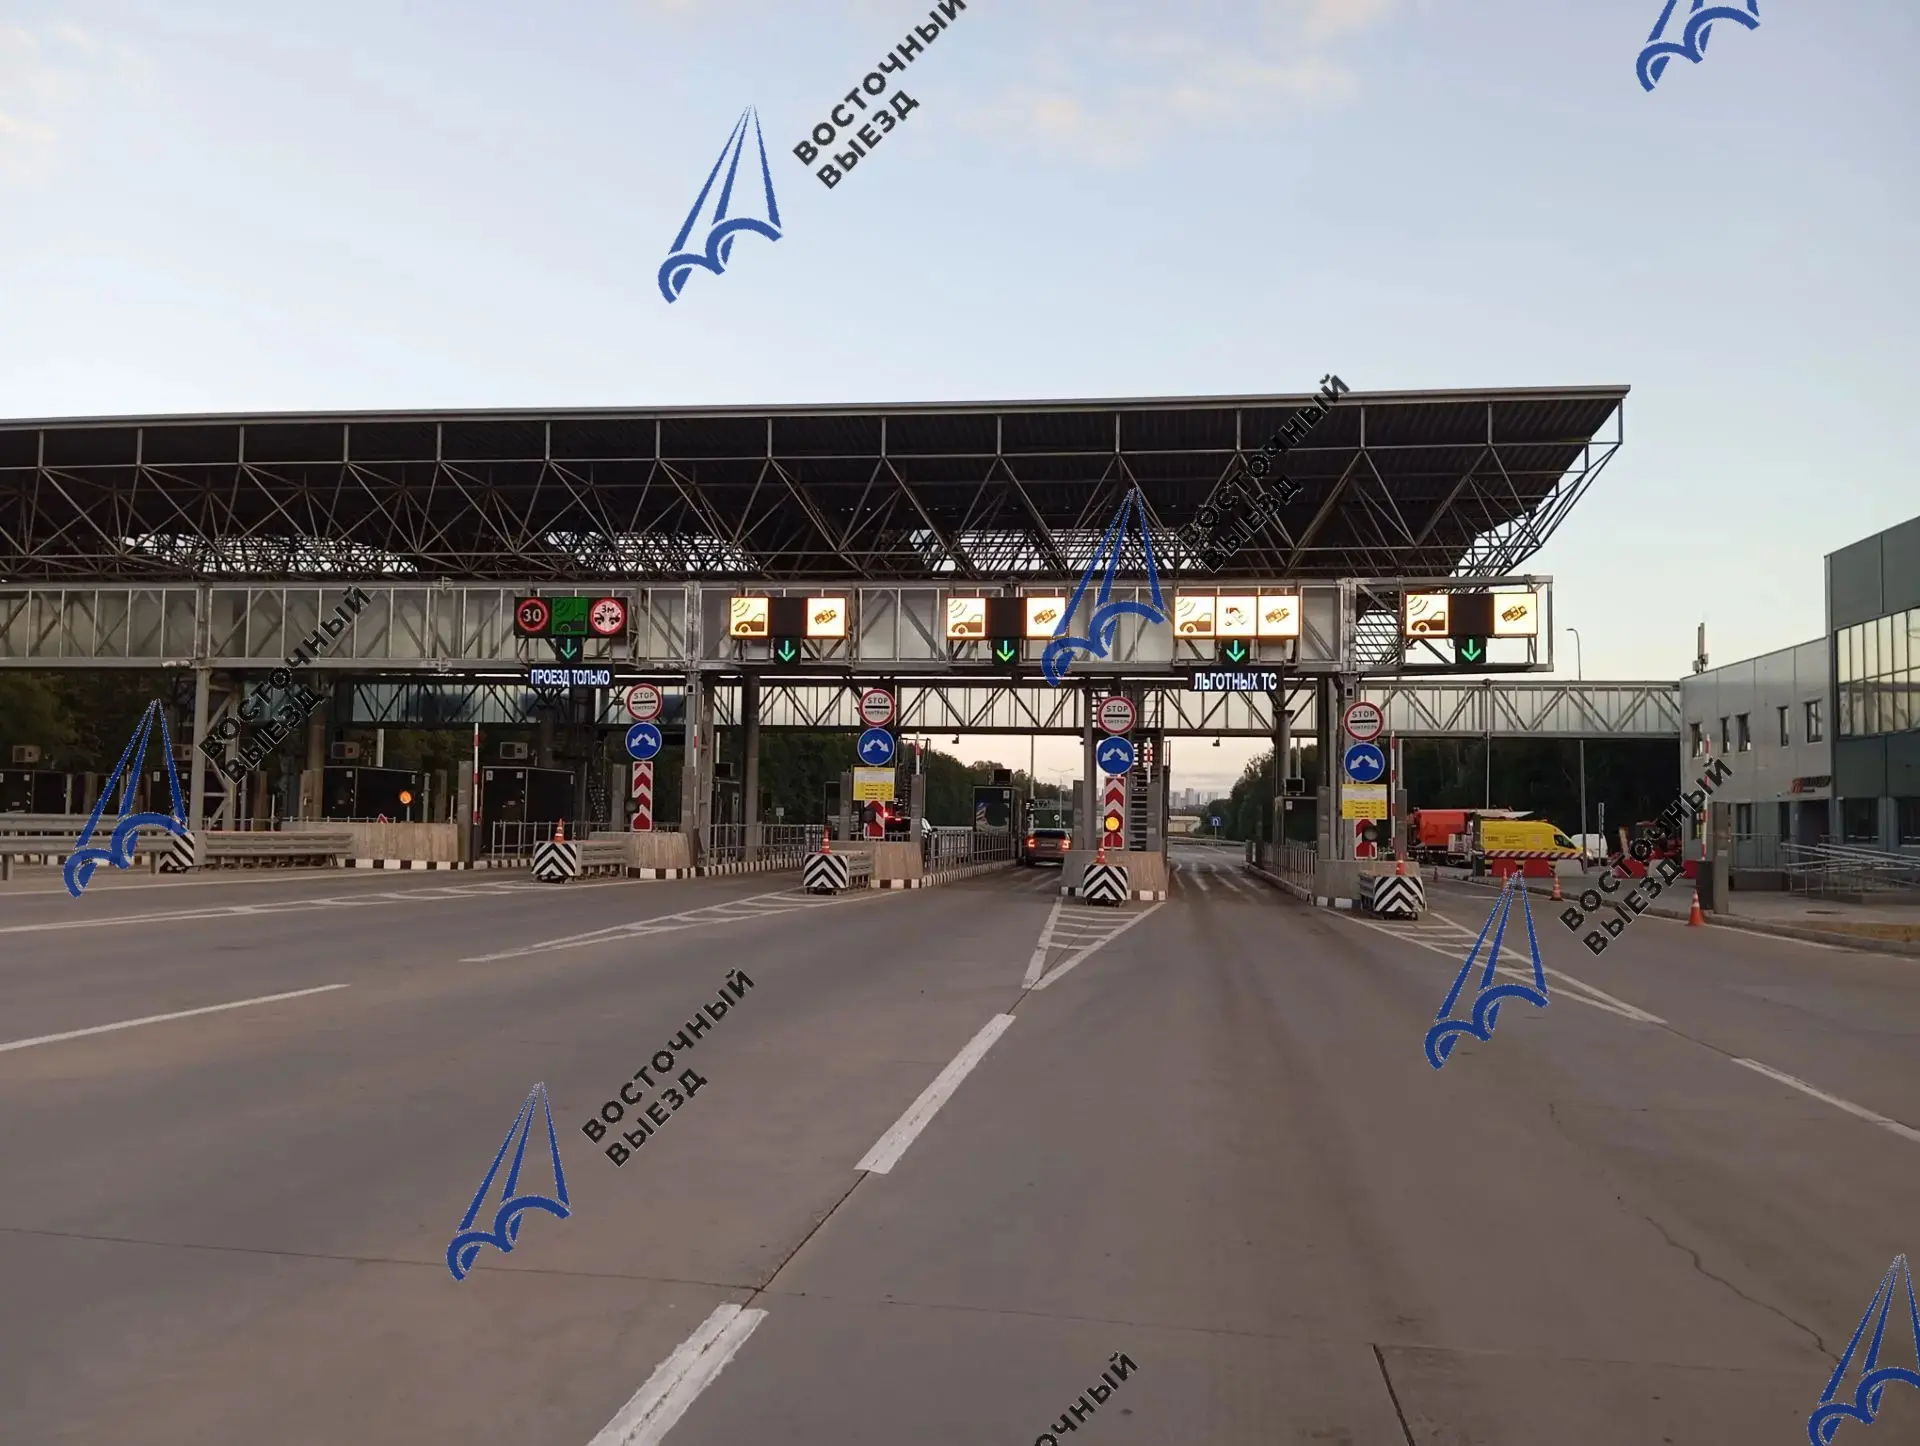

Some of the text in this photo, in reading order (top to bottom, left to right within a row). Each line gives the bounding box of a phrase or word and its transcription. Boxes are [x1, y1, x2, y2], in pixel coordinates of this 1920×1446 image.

[523, 609, 541, 622] 30
[531, 669, 610, 687] ПРОЕЗД ТОЛЬКО
[1194, 672, 1277, 690] ЛЬГОТНЫХ ТС
[1352, 710, 1375, 718] STOP
